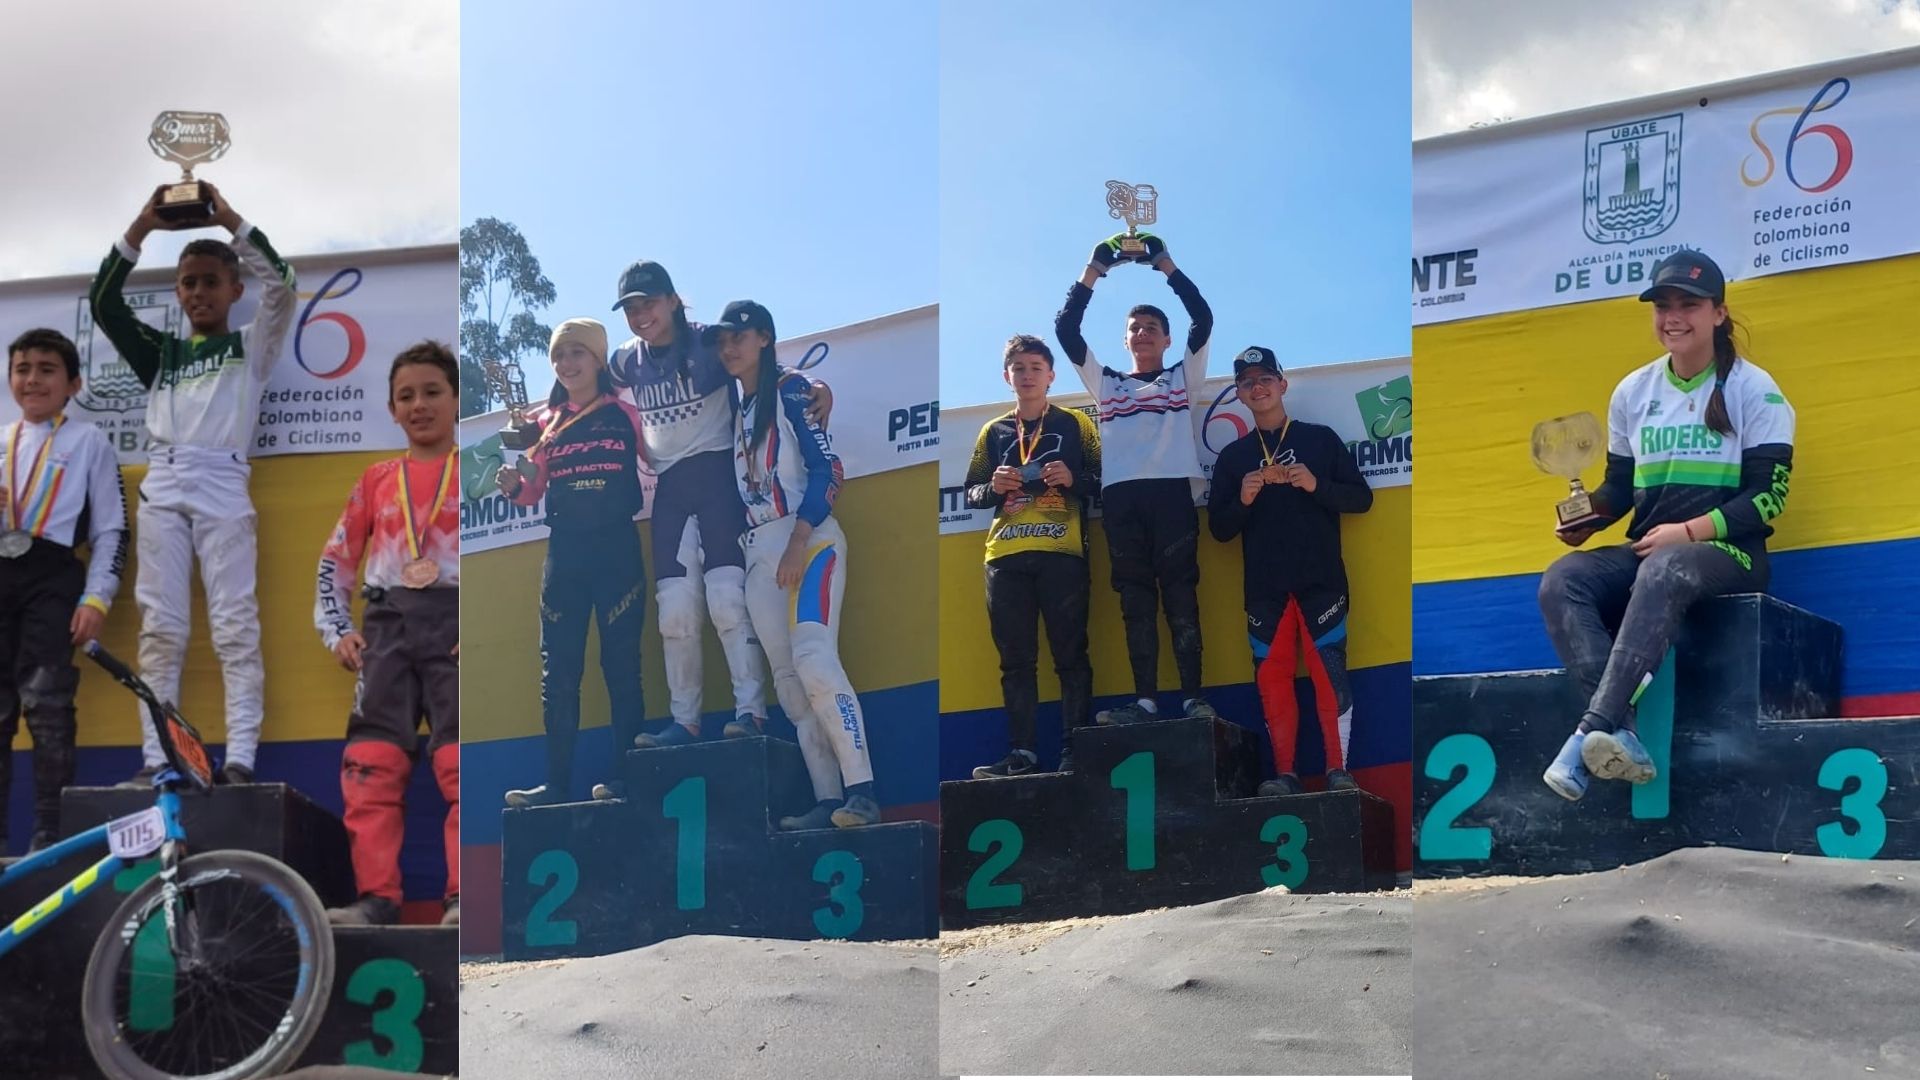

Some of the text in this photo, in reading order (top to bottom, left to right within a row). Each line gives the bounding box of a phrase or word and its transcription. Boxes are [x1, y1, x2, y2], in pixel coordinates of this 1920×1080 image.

[1612, 122, 1657, 140] UBATE
[1754, 197, 1851, 224] Federación
[1613, 227, 1645, 239] 1592
[1754, 221, 1850, 246] Colombiana
[1568, 251, 1623, 268] ALCALDÍA
[1754, 243, 1849, 268] de Ciclismo
[1556, 269, 1590, 293] DE
[258, 410, 363, 426] Colombiana
[257, 430, 362, 448] de Ciclismo
[897, 440, 921, 453] PISTA
[1641, 424, 1722, 456] RIDERS
[1420, 734, 1888, 860] 2 3
[1111, 752, 1156, 871] 1
[119, 821, 154, 848] 1115
[663, 777, 706, 910] 1
[966, 815, 1309, 910] 2 3
[525, 850, 864, 946] 2 3
[345, 958, 425, 1073] 3
